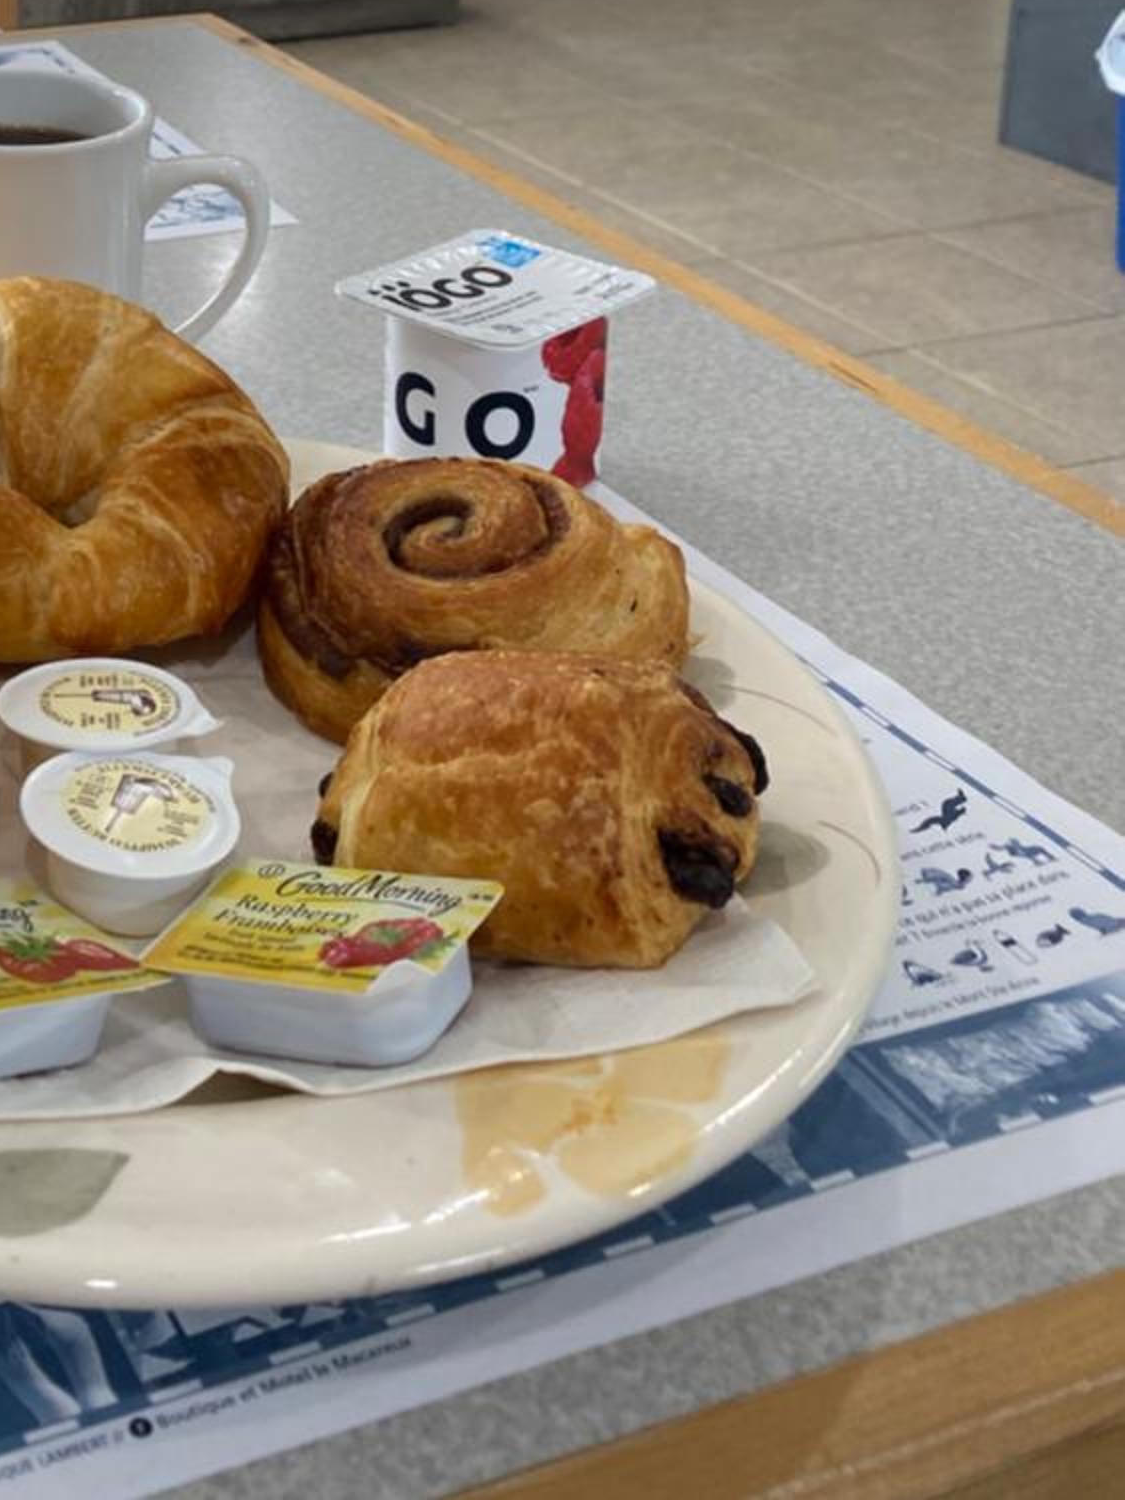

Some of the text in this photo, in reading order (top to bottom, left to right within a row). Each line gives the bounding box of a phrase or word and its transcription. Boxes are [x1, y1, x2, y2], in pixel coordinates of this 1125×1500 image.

[236, 893, 361, 925] Raspberry
[157, 1395, 238, 1432] Boutique
[260, 1368, 314, 1398] Motel
